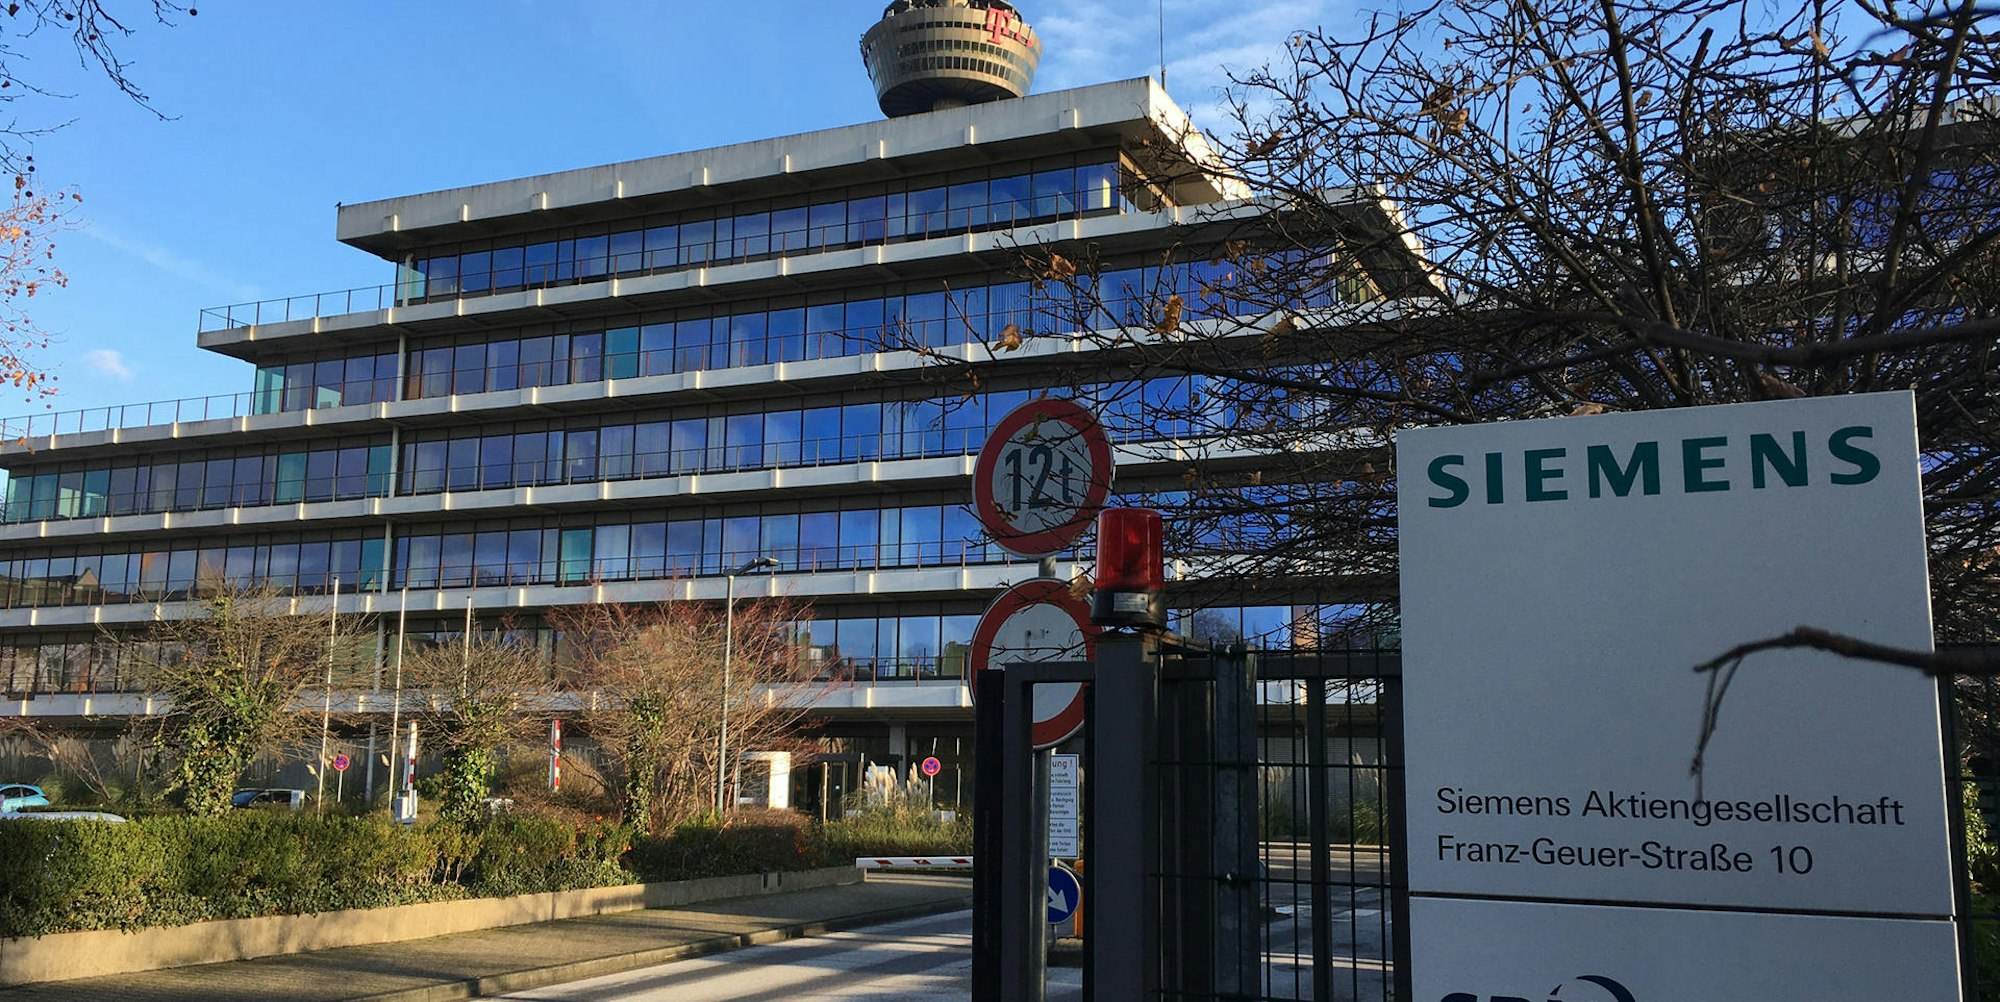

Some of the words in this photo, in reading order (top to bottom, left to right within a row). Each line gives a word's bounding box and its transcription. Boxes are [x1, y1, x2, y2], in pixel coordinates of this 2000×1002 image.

[1427, 426, 1881, 508] SIEMENS
[1436, 787, 1571, 817] Siemens
[1581, 790, 1906, 827] Aktiengesellschaft
[1437, 834, 1753, 873] Franz-Geuer-Straße
[1769, 845, 1814, 875] 10
